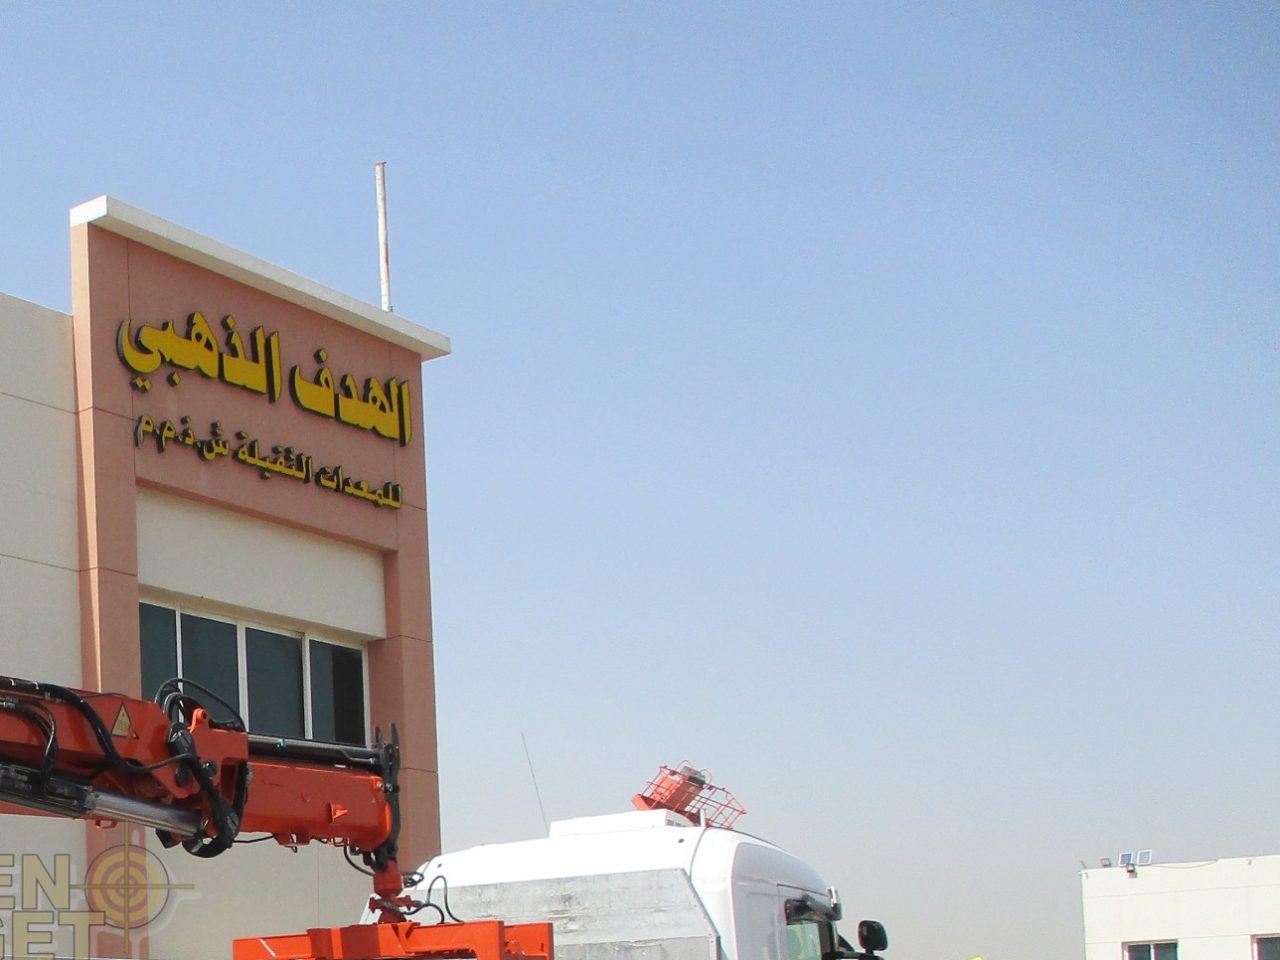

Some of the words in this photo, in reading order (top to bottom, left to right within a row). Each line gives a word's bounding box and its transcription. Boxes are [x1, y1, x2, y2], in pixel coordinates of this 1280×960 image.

[116, 311, 283, 402] الذهبي
[289, 347, 412, 446] الهدف
[231, 431, 314, 484] الثقيلة
[316, 464, 404, 509] للمعدات
